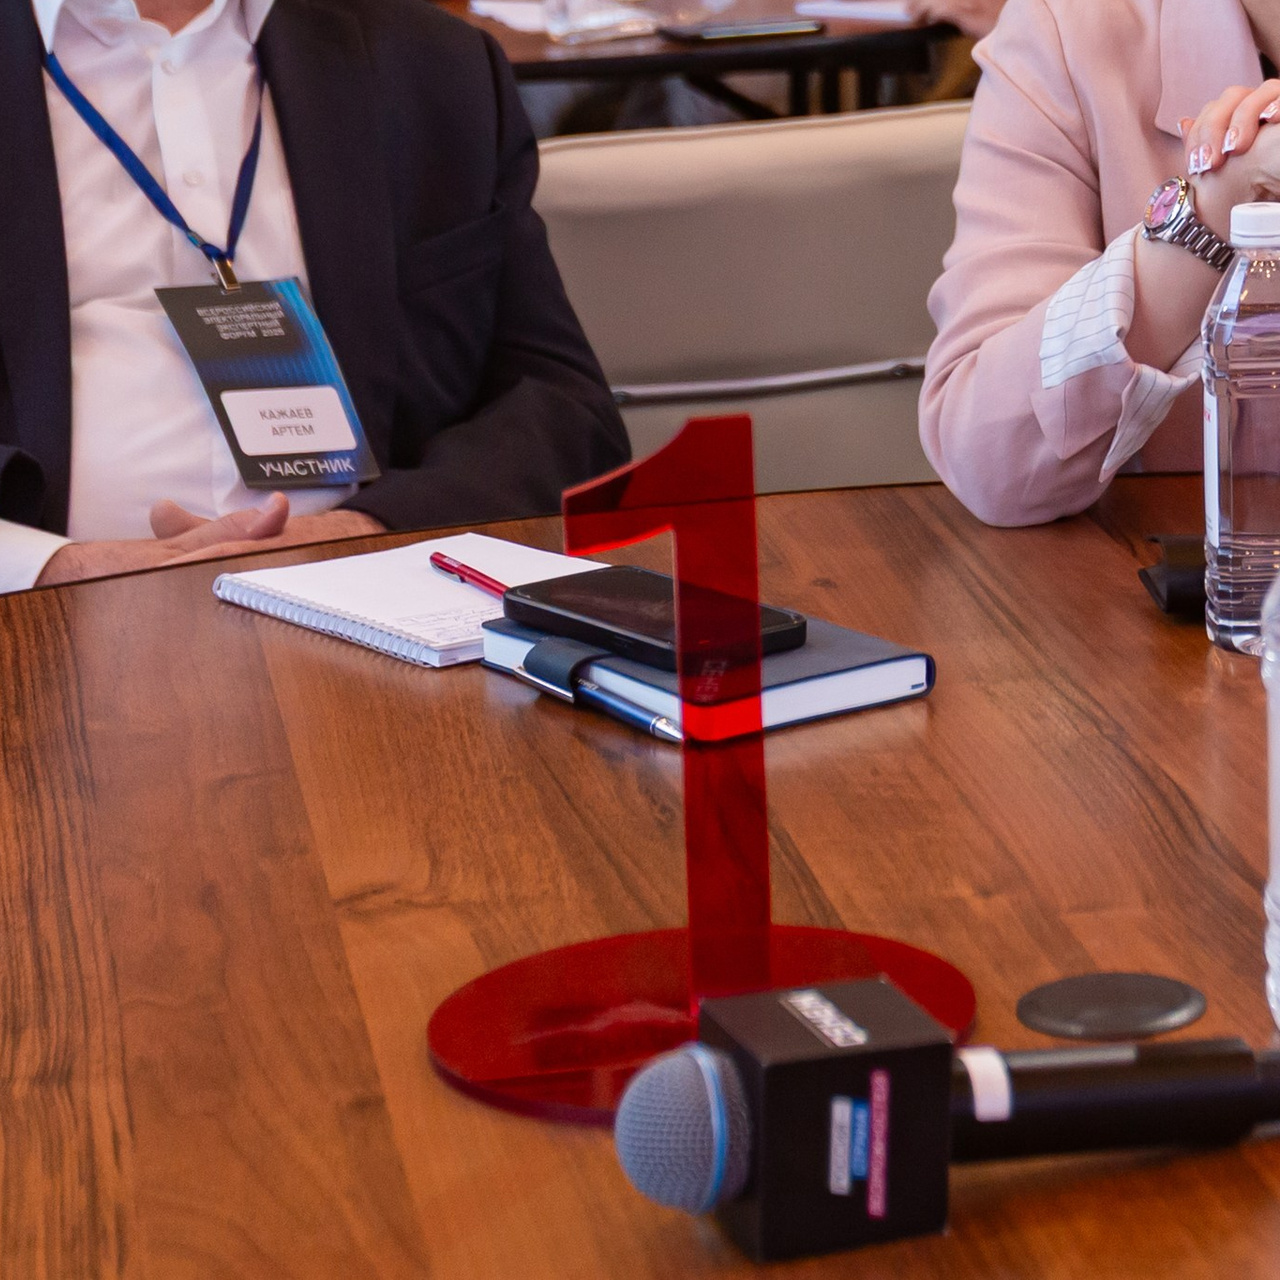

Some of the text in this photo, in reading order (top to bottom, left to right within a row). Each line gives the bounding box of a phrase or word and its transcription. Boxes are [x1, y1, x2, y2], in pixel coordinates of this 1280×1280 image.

[258, 407, 314, 420] КАЖАЕВ
[270, 423, 315, 437] АРТЕМ
[259, 457, 356, 478] УЧАСТНИК
[562, 412, 773, 1005] 1
